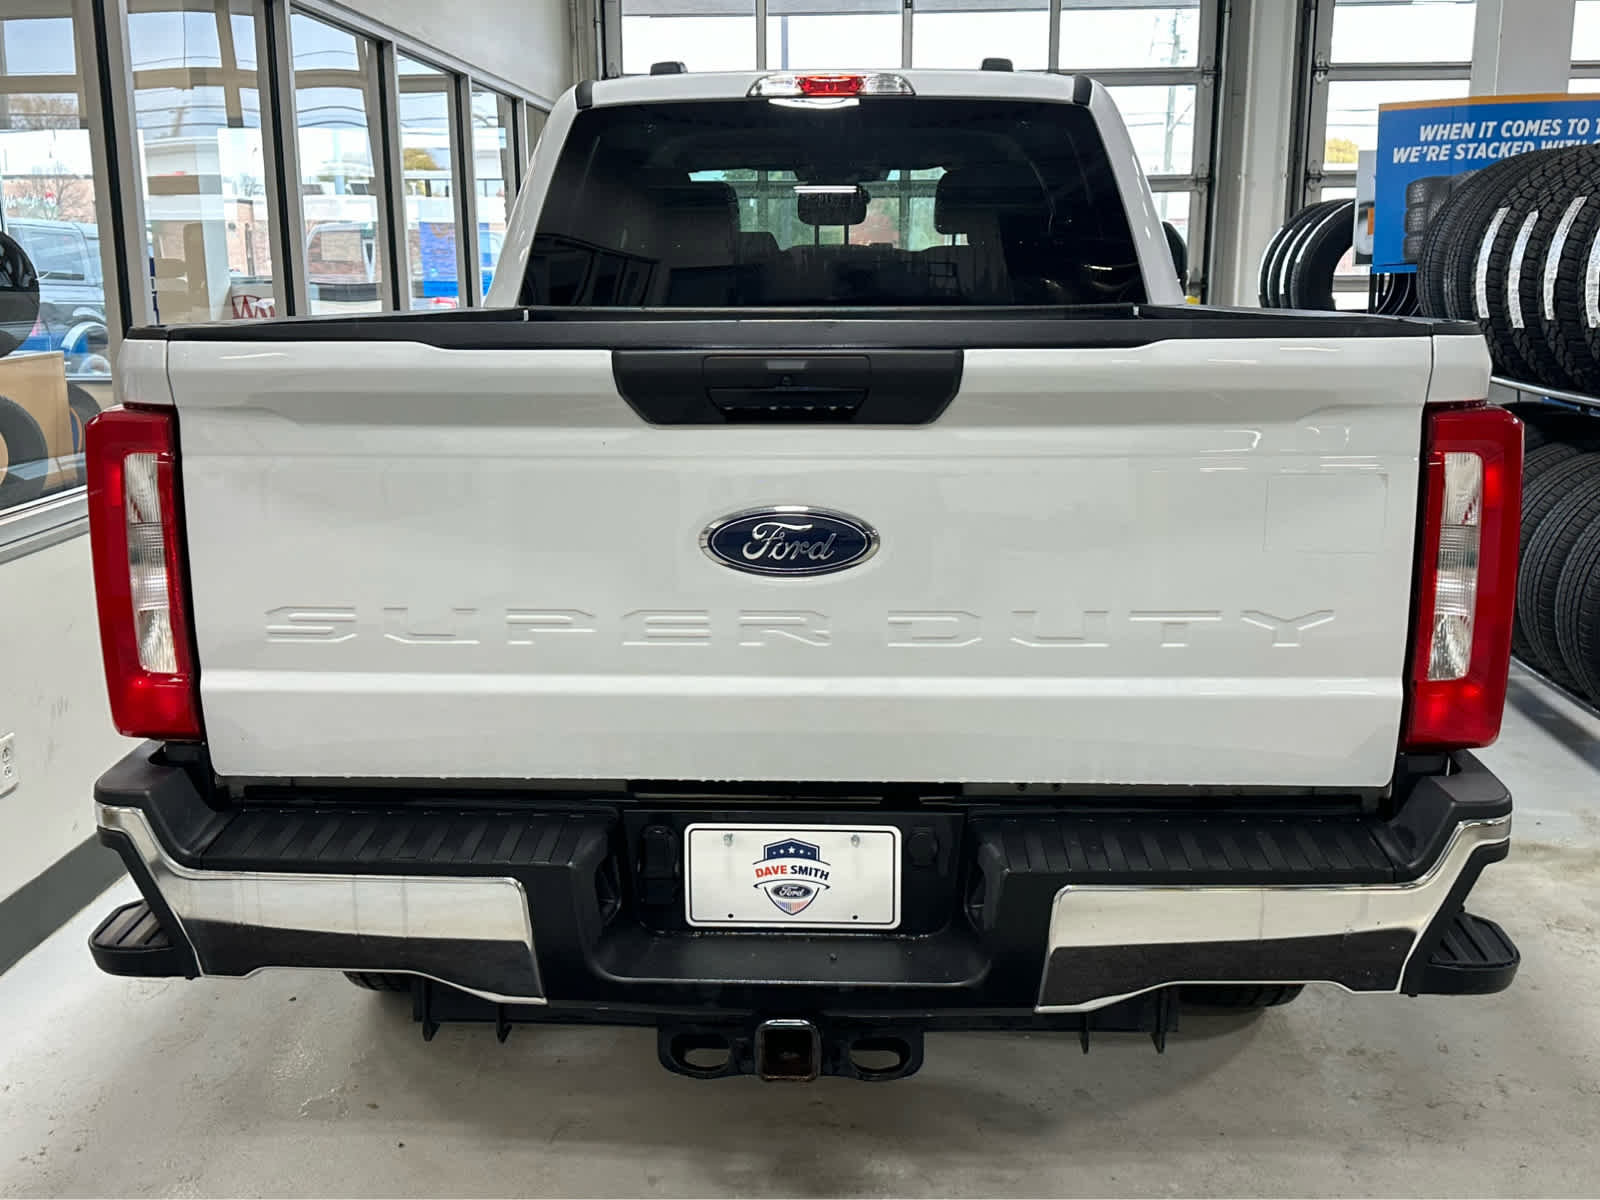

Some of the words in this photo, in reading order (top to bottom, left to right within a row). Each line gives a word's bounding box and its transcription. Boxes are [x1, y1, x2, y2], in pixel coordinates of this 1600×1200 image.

[1419, 121, 1476, 142] WHEN
[1478, 120, 1498, 139] IT
[1501, 118, 1562, 138] COMES
[1567, 117, 1590, 136] TO
[1392, 143, 1452, 164] WE'RE
[742, 521, 837, 560] Ford
[265, 606, 832, 647] SUPER
[887, 609, 1335, 648] DUTY
[755, 864, 788, 879] DAVE
[790, 864, 830, 881] SMITH
[778, 886, 805, 897] Ford
